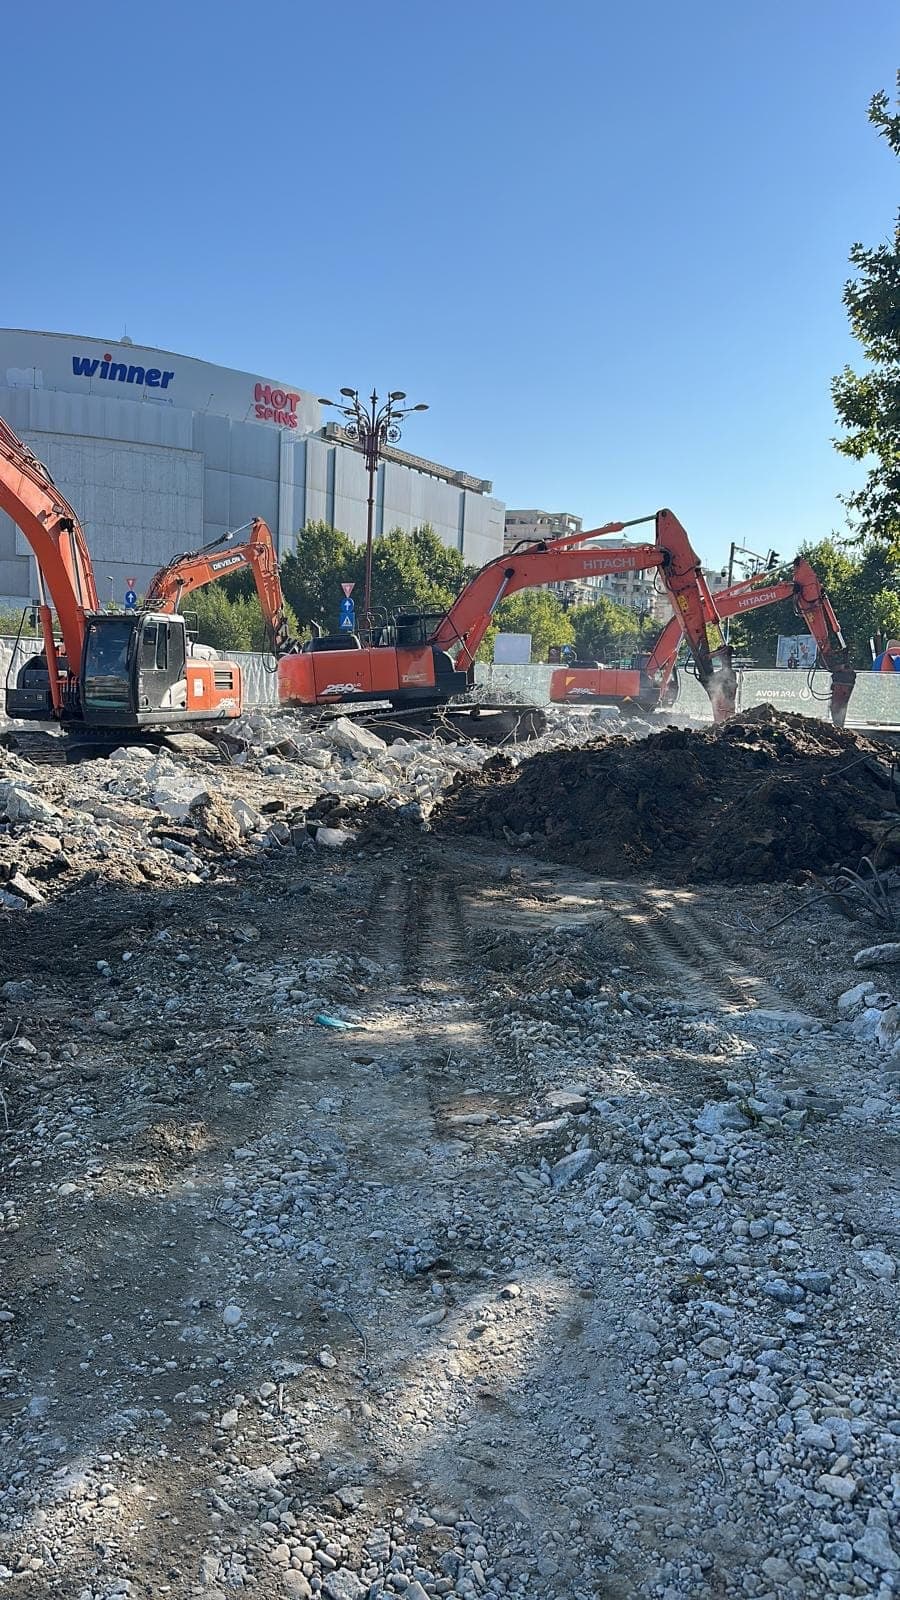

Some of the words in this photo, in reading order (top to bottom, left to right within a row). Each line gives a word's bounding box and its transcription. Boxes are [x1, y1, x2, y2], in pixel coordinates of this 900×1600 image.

[72, 354, 175, 389] winner
[254, 383, 302, 412] HOT
[255, 404, 299, 429] SPINS
[213, 556, 241, 571] DEVELON
[583, 557, 636, 570] HITACHI
[739, 592, 777, 608] HITACHI
